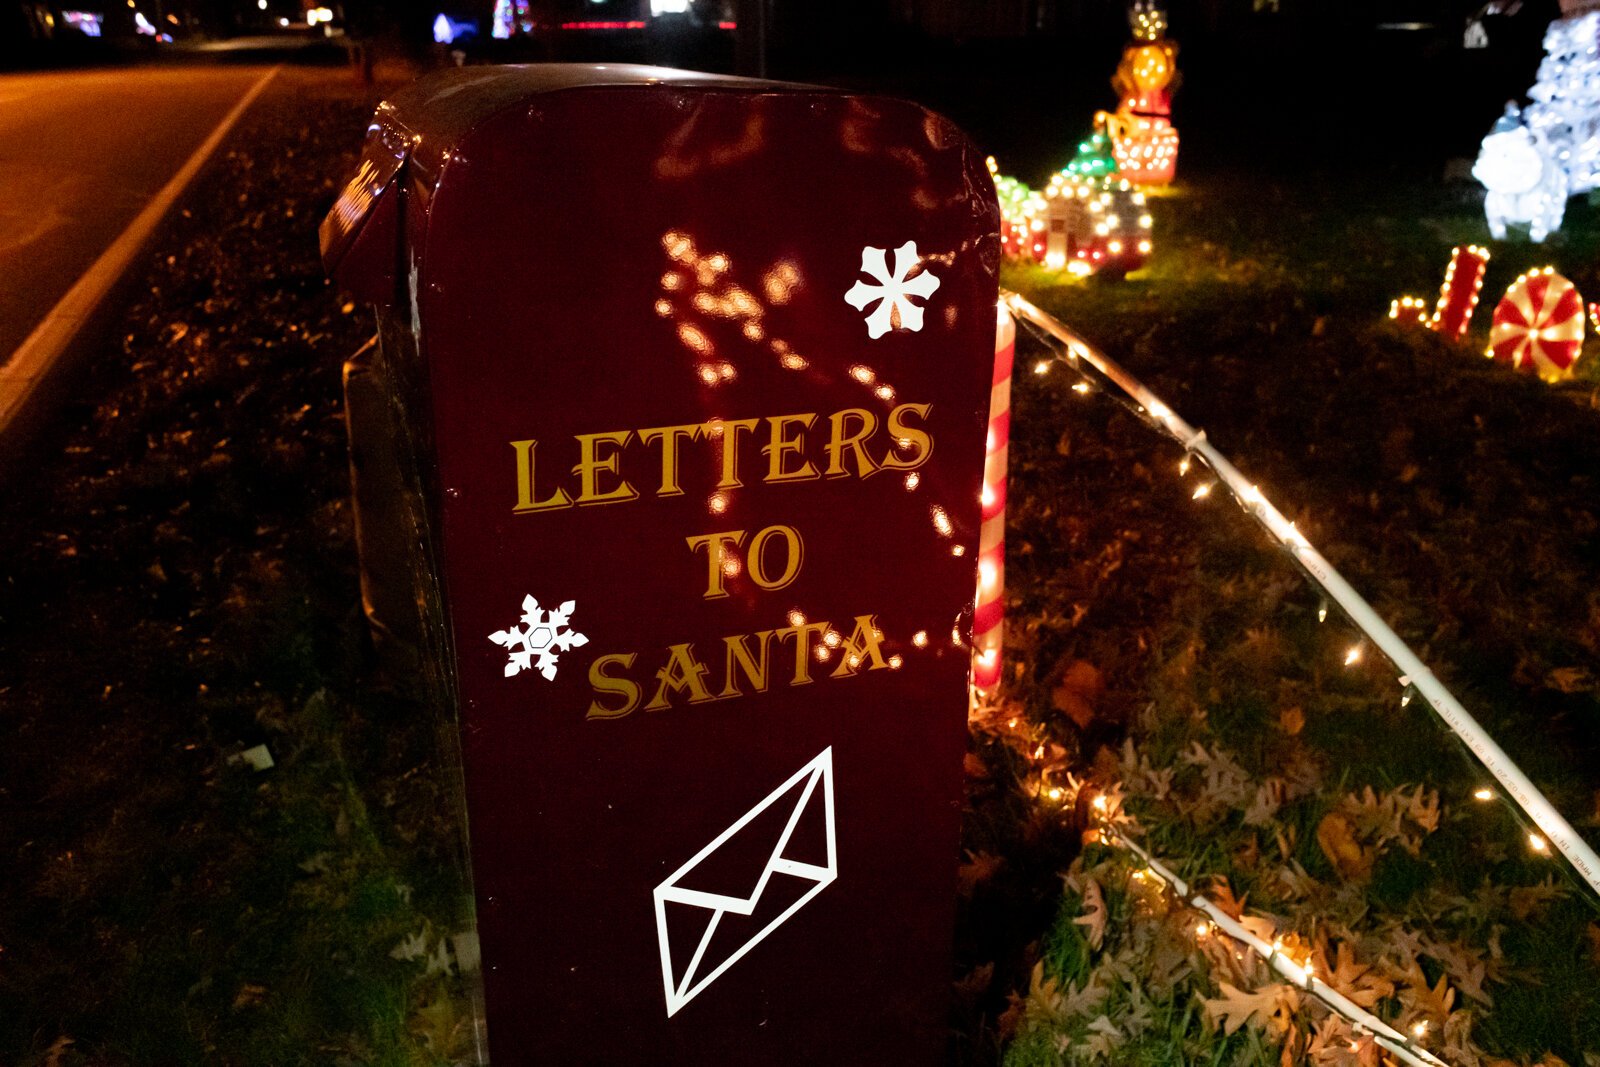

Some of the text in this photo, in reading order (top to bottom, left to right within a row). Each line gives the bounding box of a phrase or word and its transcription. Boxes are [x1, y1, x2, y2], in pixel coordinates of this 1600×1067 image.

[509, 403, 935, 515] LETTERS
[685, 525, 805, 600] TO
[586, 614, 890, 721] SANTA
